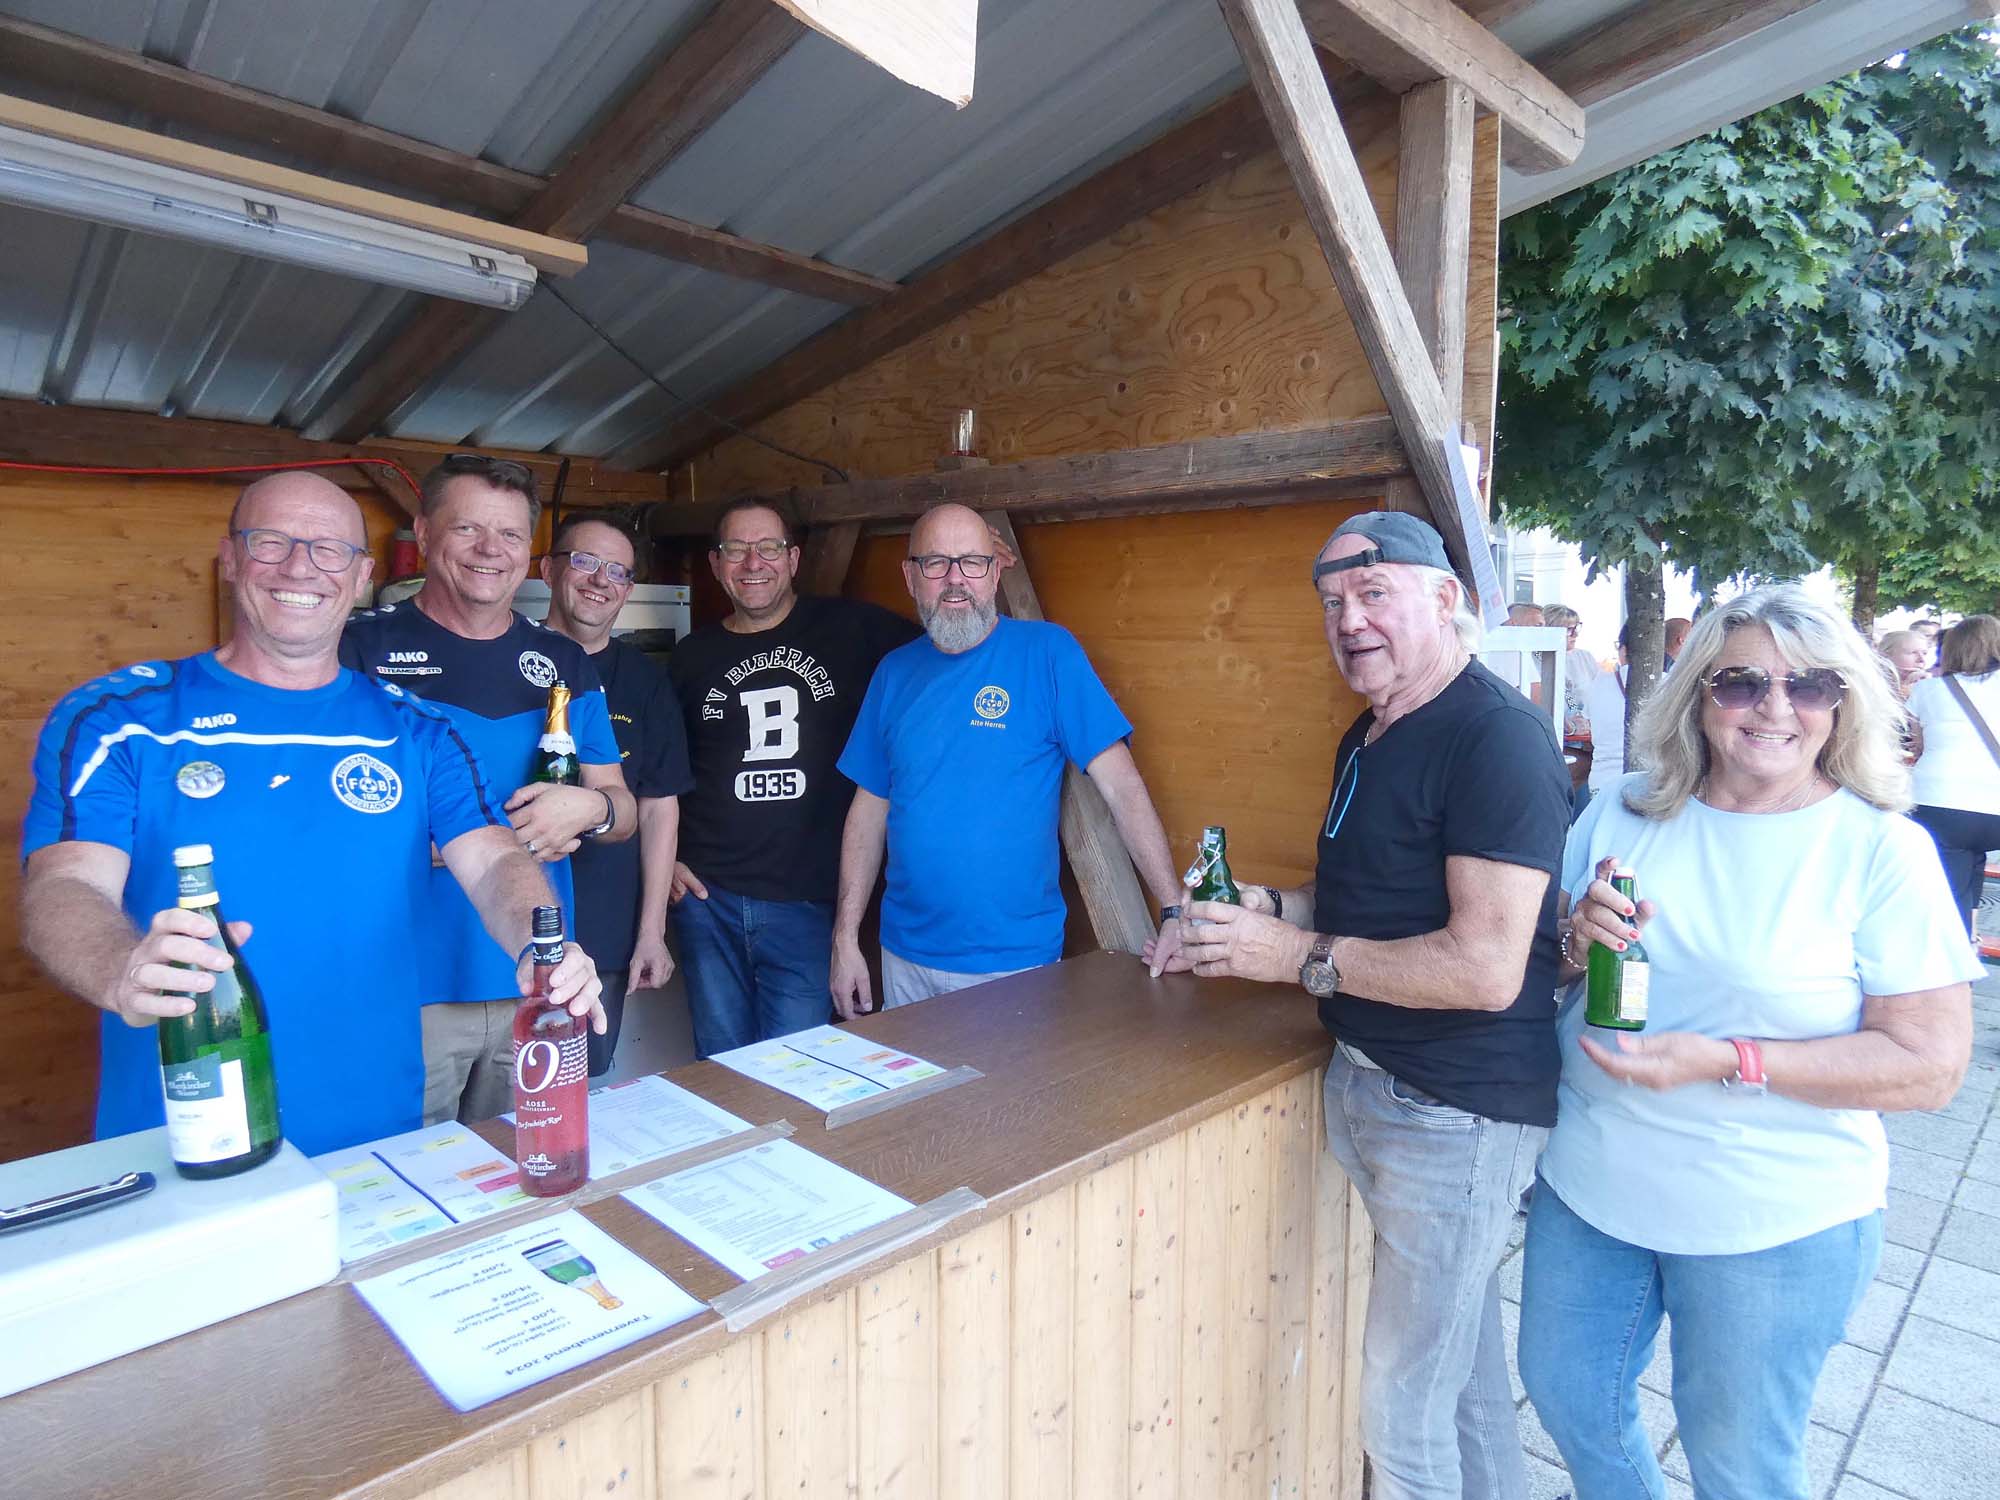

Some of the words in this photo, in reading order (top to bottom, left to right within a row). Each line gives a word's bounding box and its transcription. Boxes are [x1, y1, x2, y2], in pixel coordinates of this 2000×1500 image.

[387, 651, 429, 663] JAKO
[702, 687, 728, 720] FV
[724, 646, 836, 702] BIBERACH
[191, 712, 238, 729] JAKO
[739, 685, 799, 762] B
[970, 719, 984, 727] Alte
[984, 720, 1006, 729] Herren
[347, 777, 358, 791] F
[377, 779, 388, 792] B
[743, 771, 797, 799] 1935
[544, 1313, 652, 1361] Tavernenabend
[504, 1358, 541, 1376] 2024
